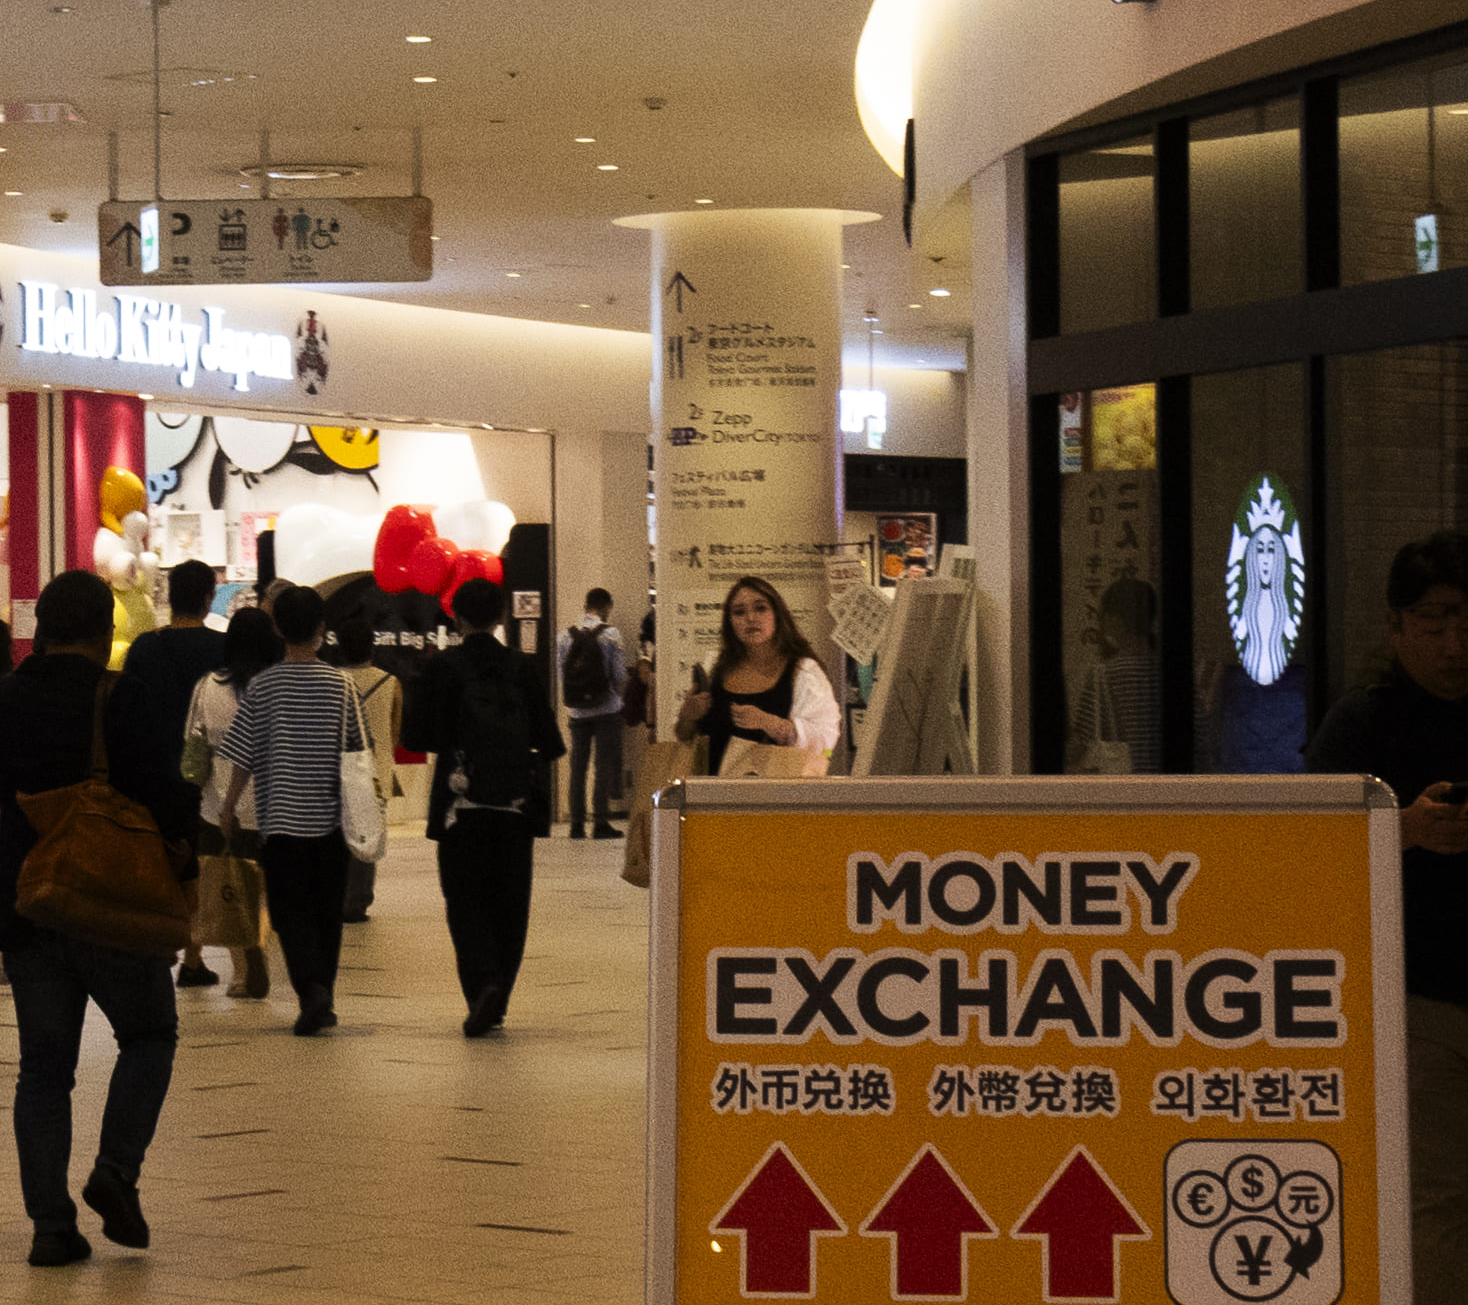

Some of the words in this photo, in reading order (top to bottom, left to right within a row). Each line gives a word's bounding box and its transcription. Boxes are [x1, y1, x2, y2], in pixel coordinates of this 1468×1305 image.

[18, 280, 116, 359] Hello
[114, 294, 202, 388] Kitty
[200, 306, 294, 392] Japan
[712, 410, 753, 428] Zepp
[857, 860, 1190, 928] MONEY
[714, 955, 1340, 1041] EXCHANGE
[714, 1067, 893, 1114] 外币兑换
[1154, 1072, 1344, 1121] 외화환전
